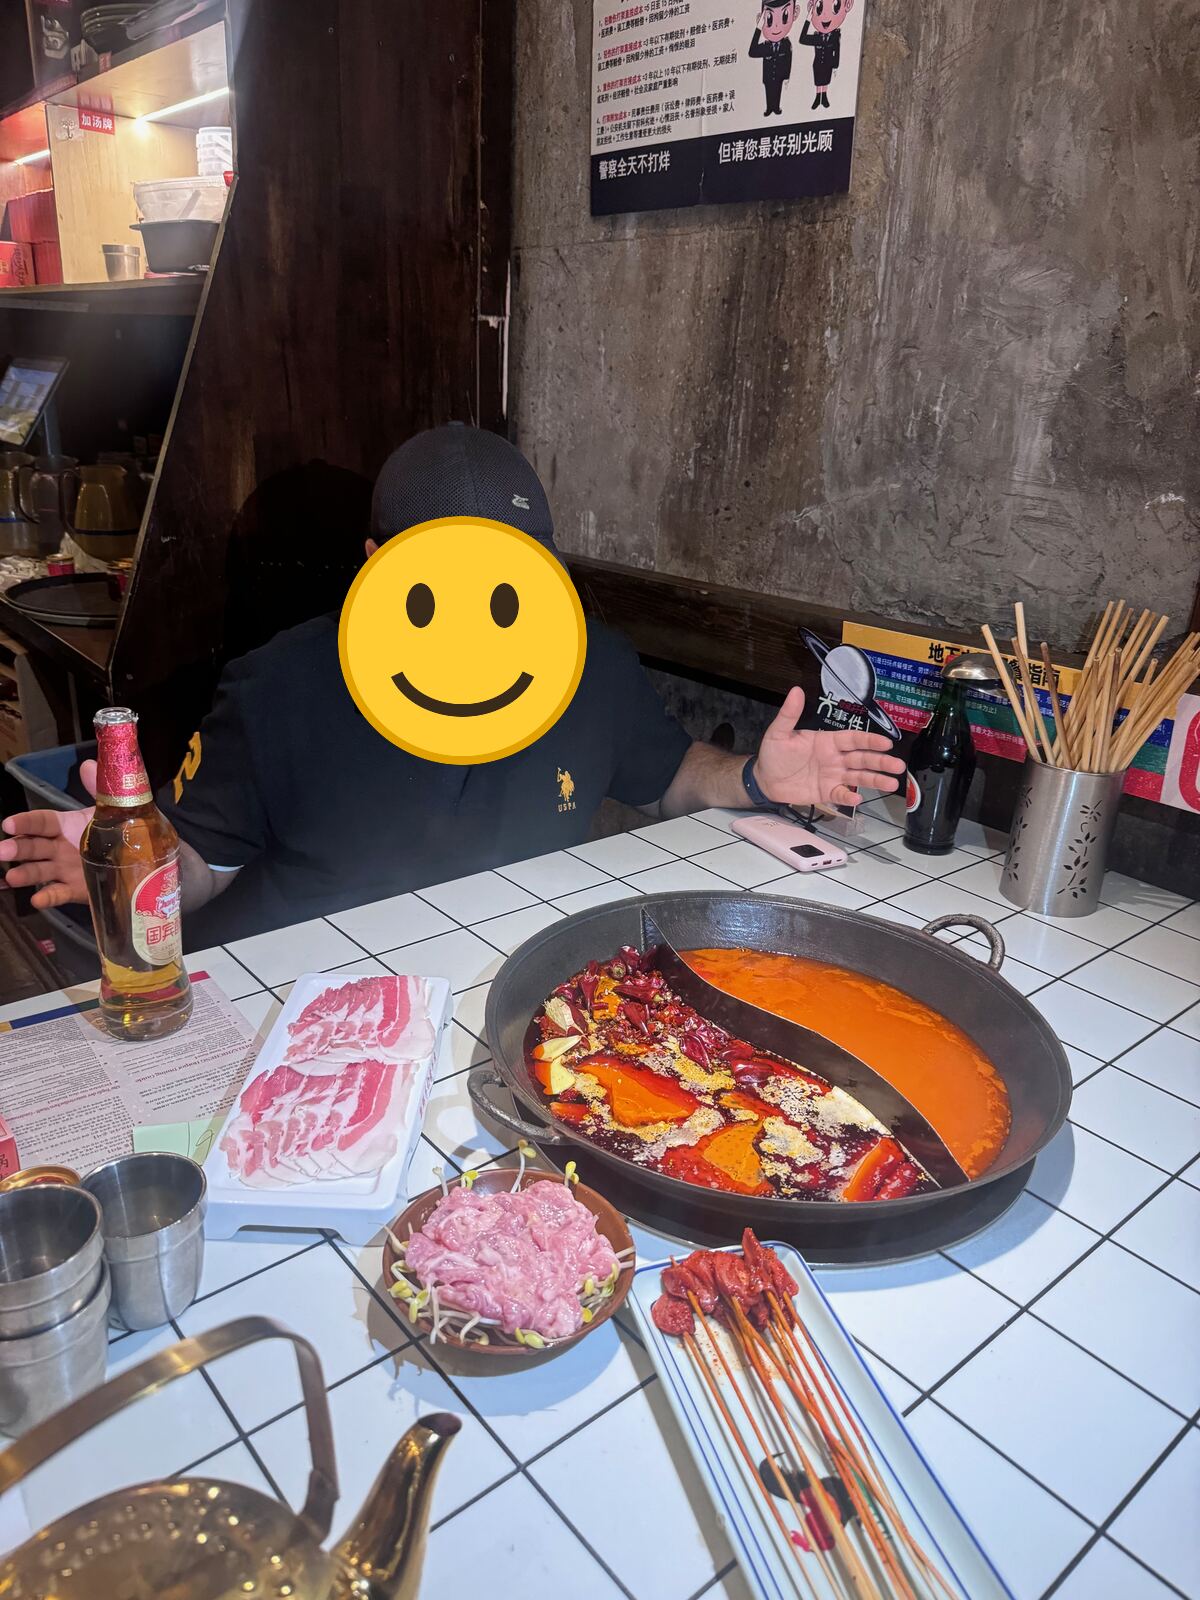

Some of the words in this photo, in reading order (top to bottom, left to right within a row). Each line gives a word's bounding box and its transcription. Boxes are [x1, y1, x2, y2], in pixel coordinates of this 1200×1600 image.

[81, 113, 113, 130] 加汤牌
[599, 150, 671, 180] 警察全天不打烊
[718, 129, 834, 165] 但请您最好别光顾
[816, 691, 864, 731] 大事件
[832, 720, 846, 730] EVENT
[557, 801, 577, 813] USPA
